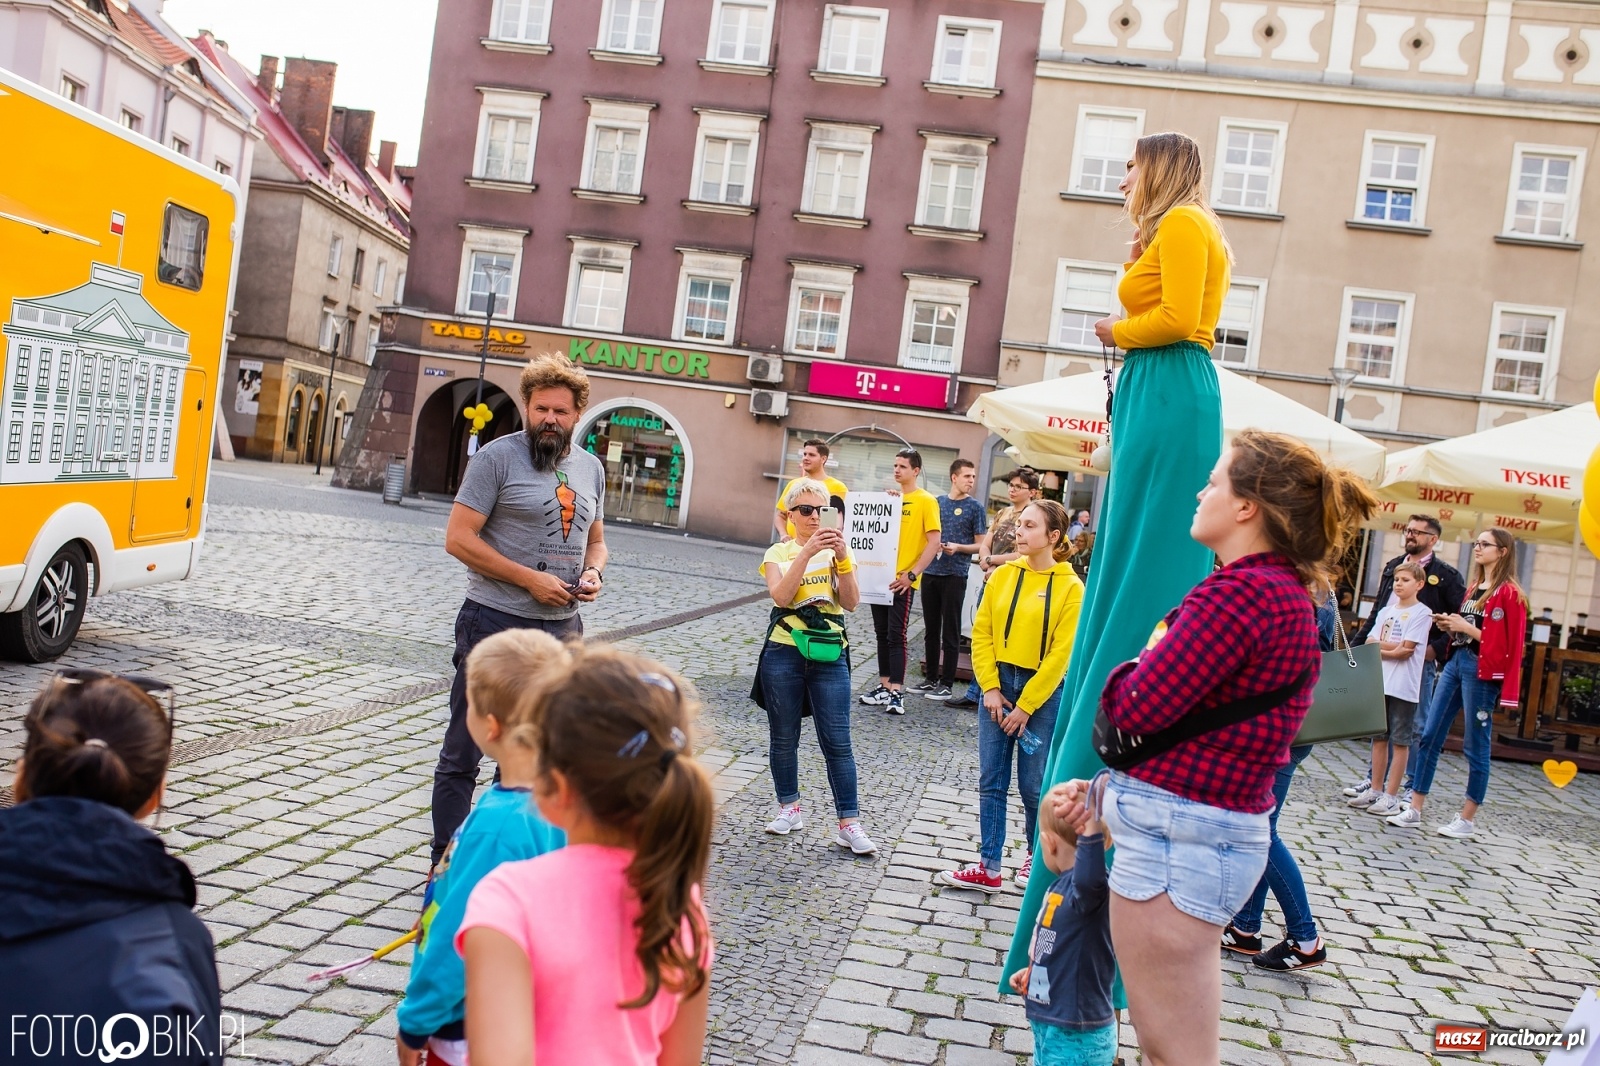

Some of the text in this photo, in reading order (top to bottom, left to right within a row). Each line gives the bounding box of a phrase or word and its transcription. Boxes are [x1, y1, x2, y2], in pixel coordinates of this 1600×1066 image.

[431, 322, 526, 345] TABAC
[568, 338, 710, 378] KANTOR
[610, 414, 662, 431] KANTOR
[1046, 415, 1108, 435] TYSKIE
[665, 444, 682, 507] KANTOR
[1501, 468, 1571, 490] TYSKIE
[853, 503, 892, 516] SZYMON
[852, 517, 889, 534] MA MÓJ
[851, 537, 874, 550] GŁOS
